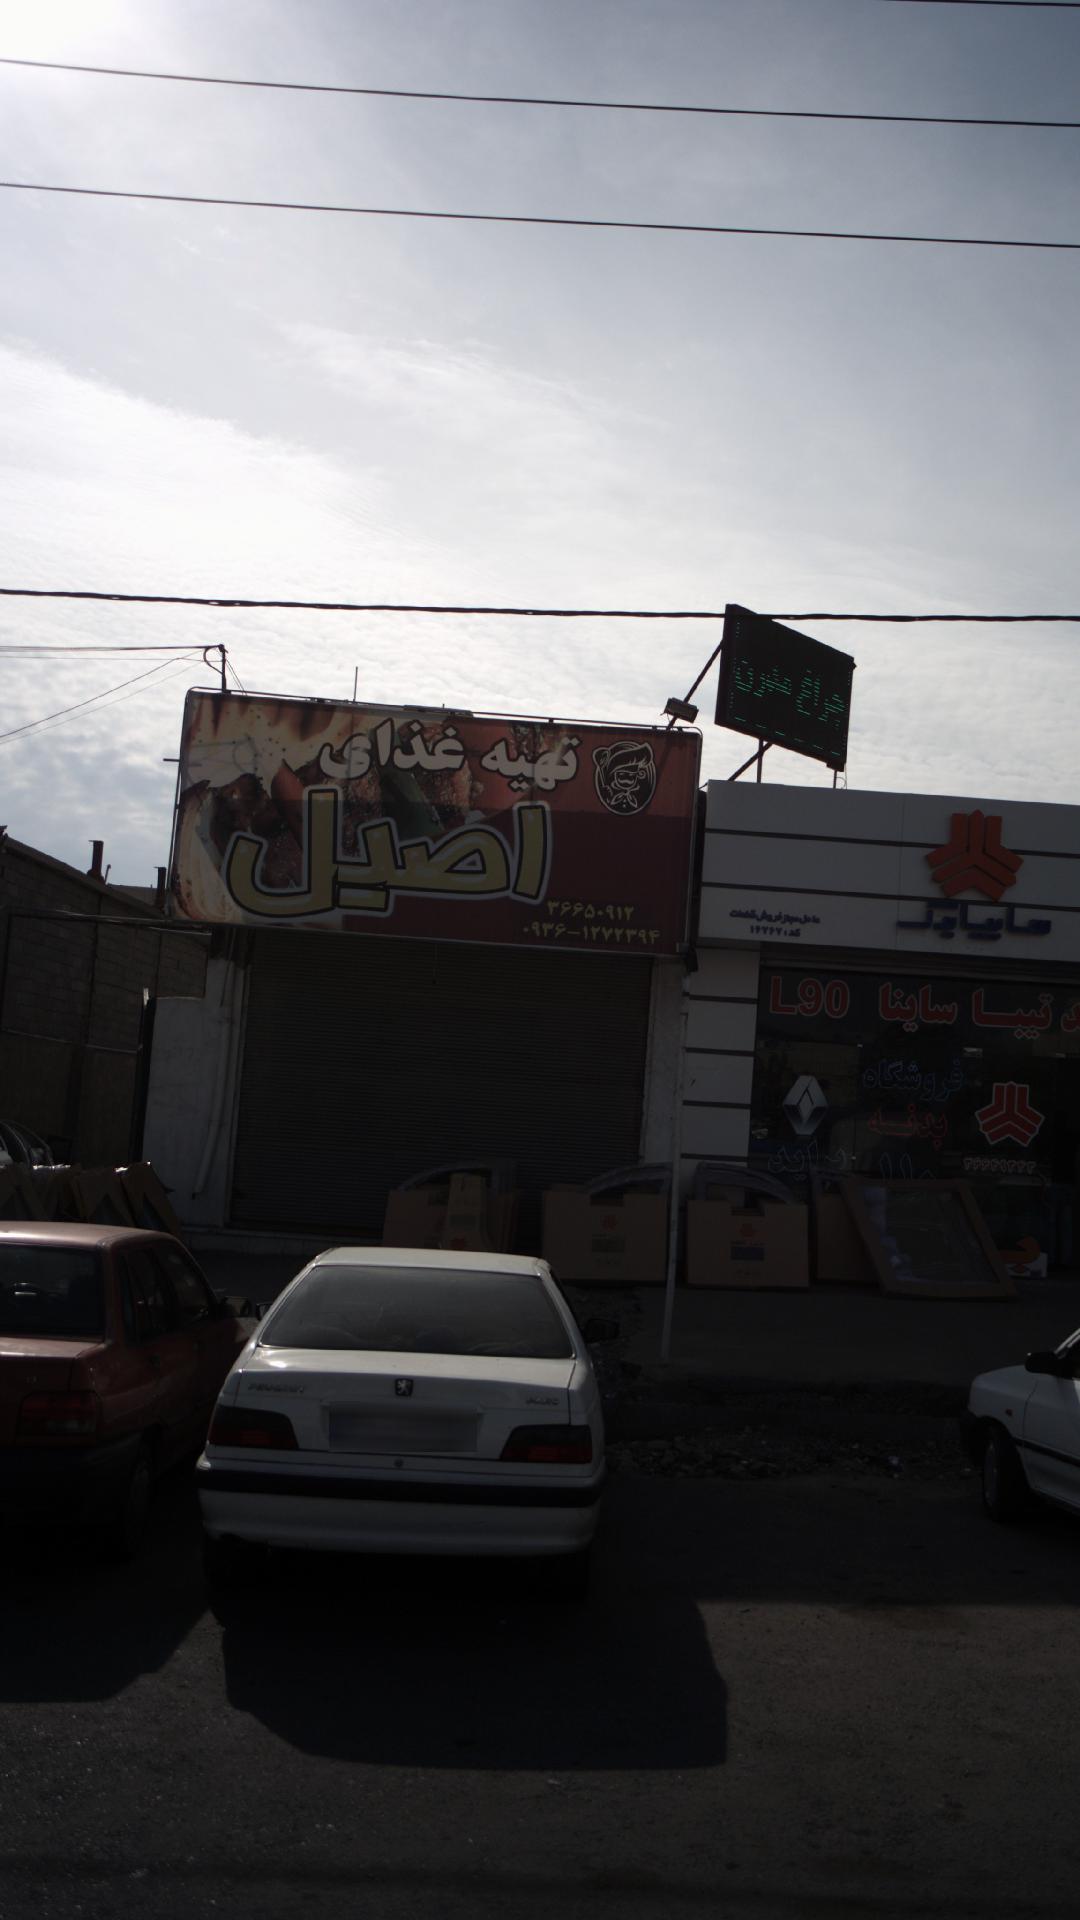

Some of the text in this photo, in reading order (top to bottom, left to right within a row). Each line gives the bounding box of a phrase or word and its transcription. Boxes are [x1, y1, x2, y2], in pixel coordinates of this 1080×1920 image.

[317, 717, 583, 792] تهیه غذای
[223, 786, 553, 919] اصیل
[769, 976, 849, 1019] L90
[879, 981, 958, 1032] ساینا
